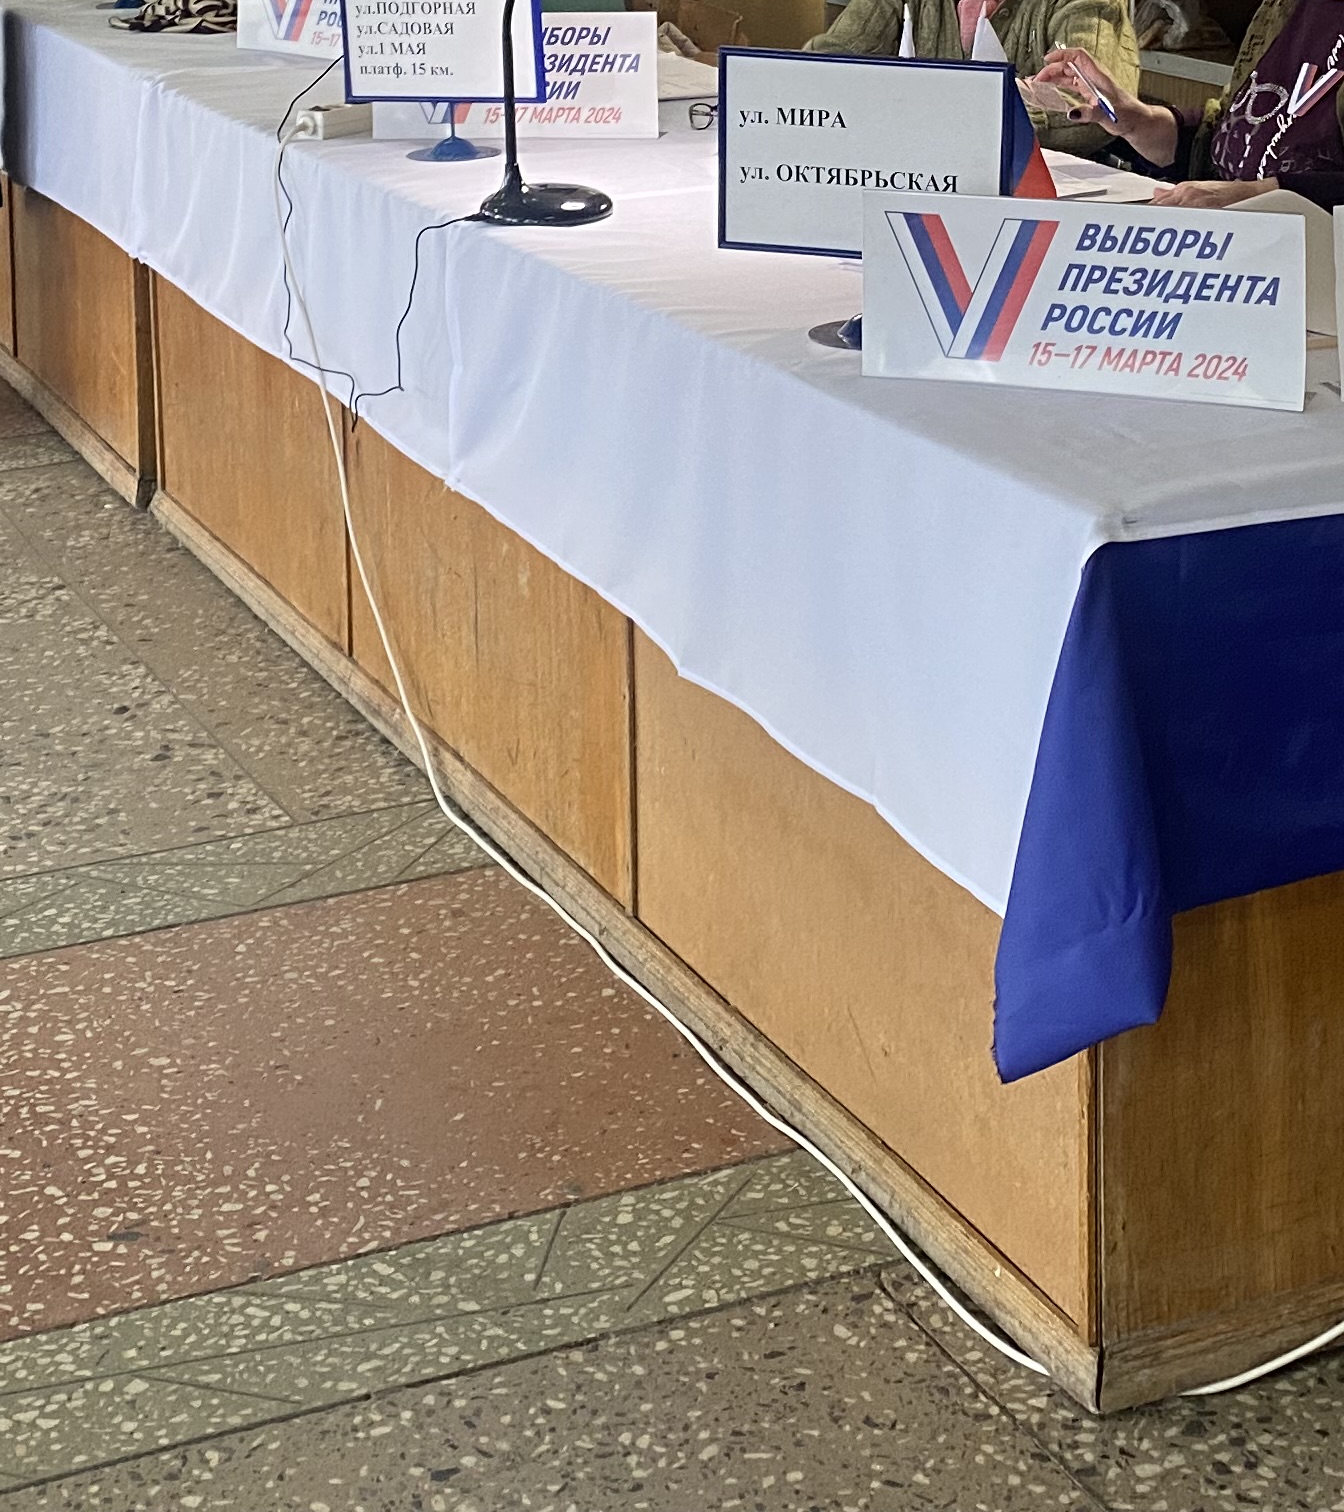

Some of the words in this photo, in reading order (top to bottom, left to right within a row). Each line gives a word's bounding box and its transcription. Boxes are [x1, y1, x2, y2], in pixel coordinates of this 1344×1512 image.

[390, 42, 427, 55] МАЯ
[360, 63, 407, 78] платф.
[411, 63, 427, 76] 15
[430, 67, 454, 76] км.
[544, 53, 641, 76] ЗИДЕНТА
[529, 107, 582, 124] МАРТА
[583, 106, 623, 124] 2024
[739, 109, 769, 128] ул.
[776, 107, 847, 128] МИРА
[740, 165, 770, 183] ул.
[776, 164, 959, 193] ОКТЯБРЬСКАЯ
[1075, 223, 1234, 261] ВЫБОРЫ
[1057, 263, 1281, 306] ПРЕЗИДЕНТА
[1040, 303, 1183, 340] РОССИИ
[1097, 346, 1184, 377] МАРТА
[1186, 353, 1249, 383] 2024
